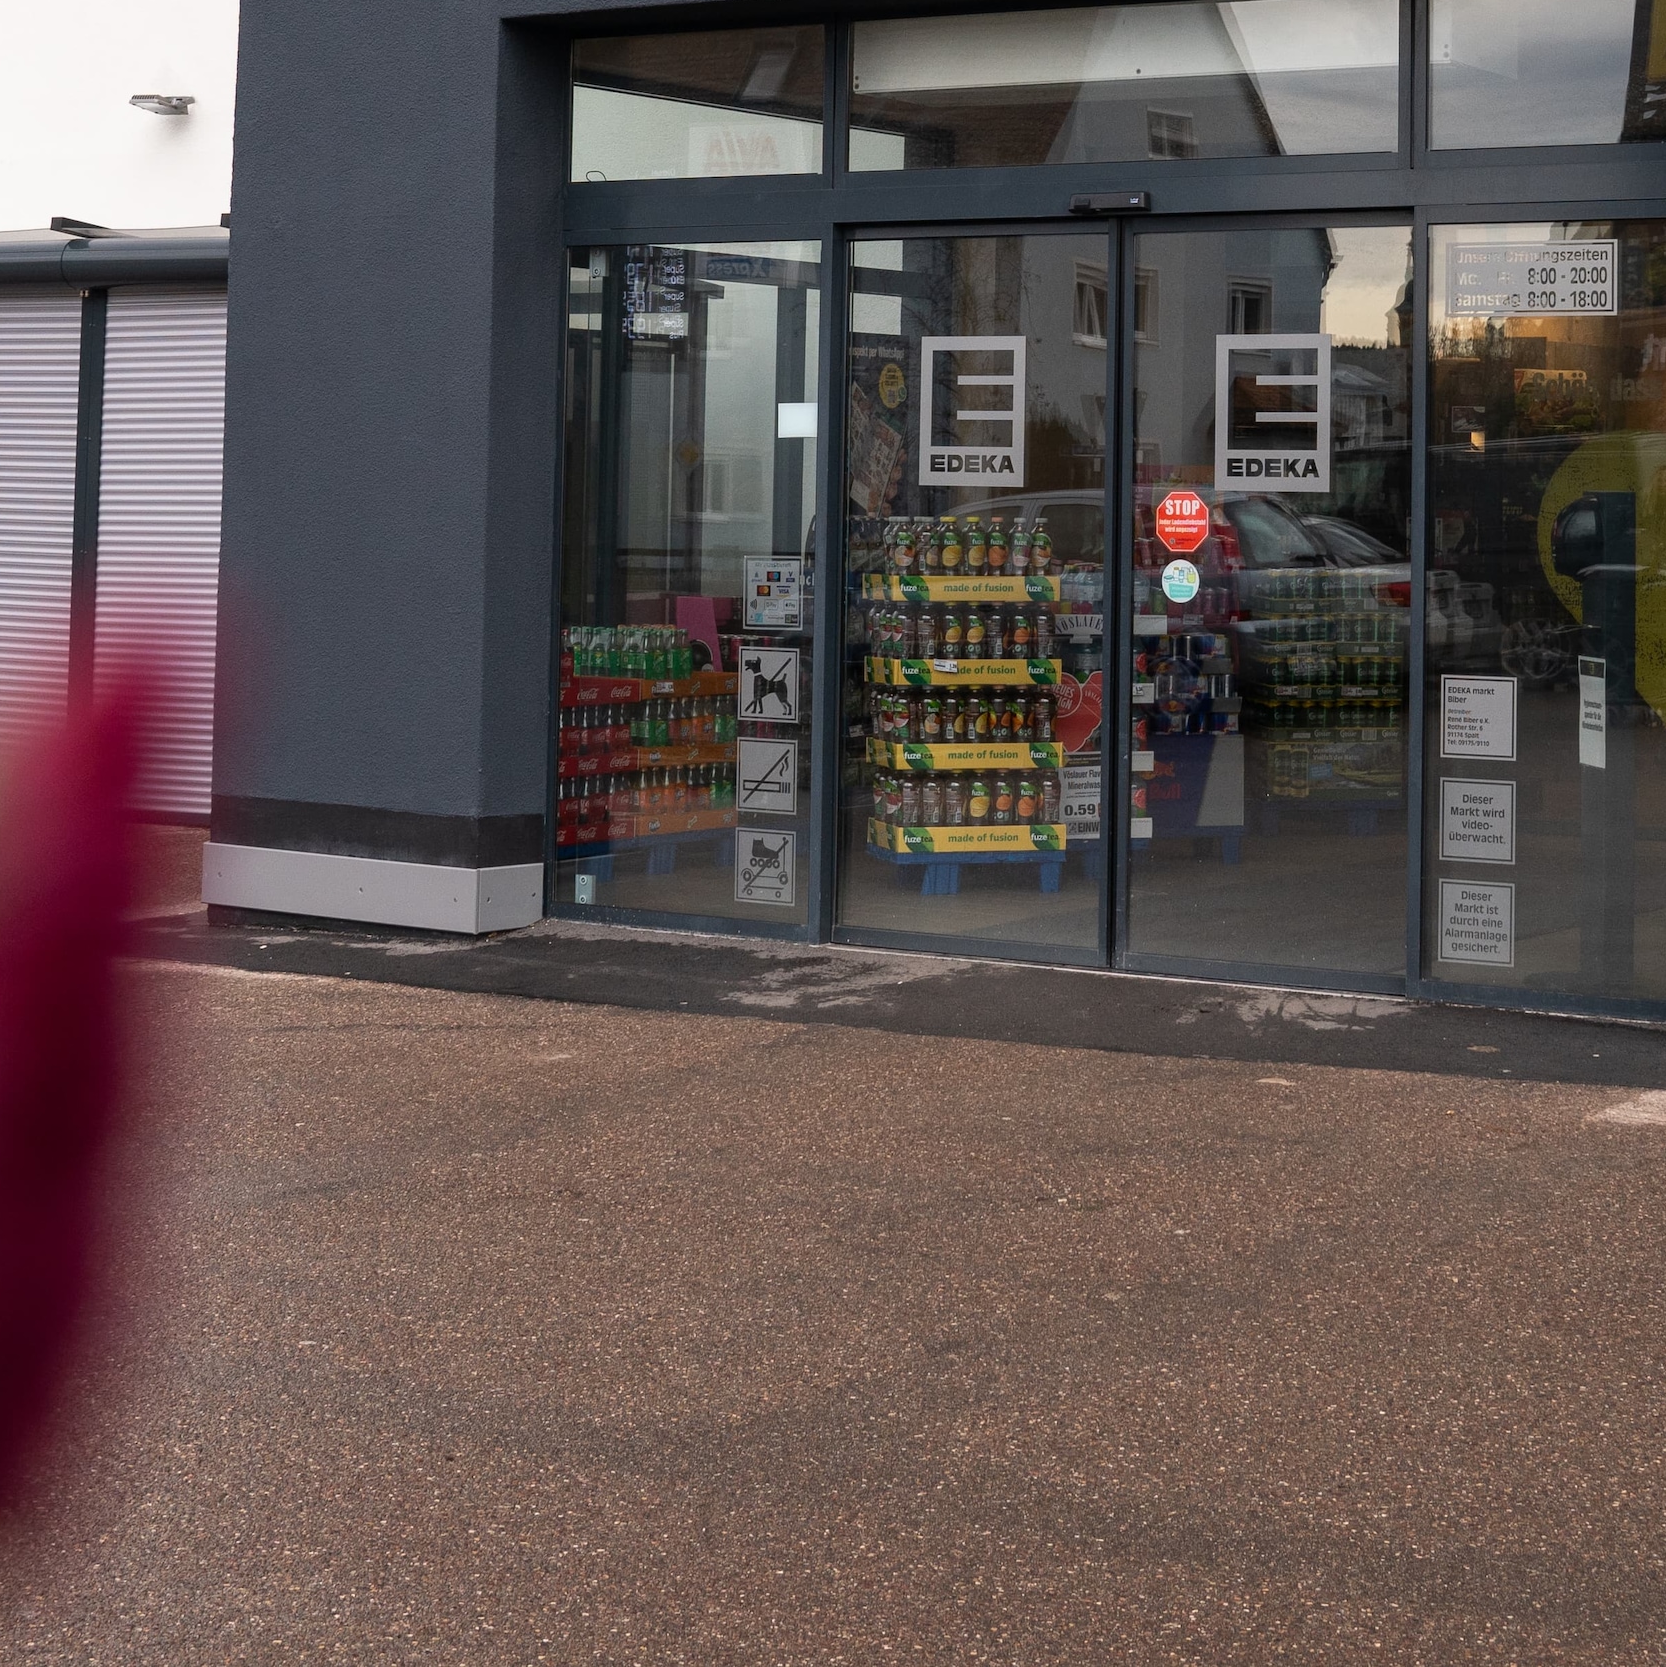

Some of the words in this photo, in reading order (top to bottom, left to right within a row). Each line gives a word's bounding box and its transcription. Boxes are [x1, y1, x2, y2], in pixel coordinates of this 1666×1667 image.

[1527, 267, 1557, 285] 8:00
[1570, 266, 1608, 284] 20:00
[1455, 292, 1521, 308] Samstag
[1527, 291, 1557, 308] 8:00
[1570, 290, 1608, 308] 18:00
[930, 454, 1015, 474] EDEKA
[1227, 458, 1320, 479] EDEKA
[1165, 499, 1200, 516] STOP
[944, 538, 957, 546] fuze
[990, 538, 1003, 546] fuze
[943, 584, 970, 592] made
[972, 584, 982, 592] of
[984, 584, 1014, 592] fusion
[974, 665, 984, 674] of
[987, 665, 1016, 675] fusion
[1448, 686, 1471, 694] EDEKA
[948, 750, 974, 759] made
[976, 749, 986, 759] of
[989, 750, 1018, 759] fusion
[1063, 770, 1088, 779] Vöslauer
[1462, 794, 1493, 805] Dieser
[1064, 803, 1096, 817] 0.59
[1450, 806, 1480, 817] Markt
[1482, 808, 1505, 818] wird
[1462, 820, 1493, 830] video-
[948, 834, 974, 842] made
[976, 833, 987, 842] of
[989, 833, 1019, 842] fusion
[1449, 831, 1506, 845] überwacht.
[1461, 890, 1493, 902] Dieser
[1454, 903, 1484, 914] Markt
[1486, 904, 1499, 915] ist
[1450, 915, 1479, 927] durch
[1482, 918, 1503, 928] eine
[1445, 928, 1508, 942] Alarmanlage
[1451, 941, 1501, 954] gesichert.
